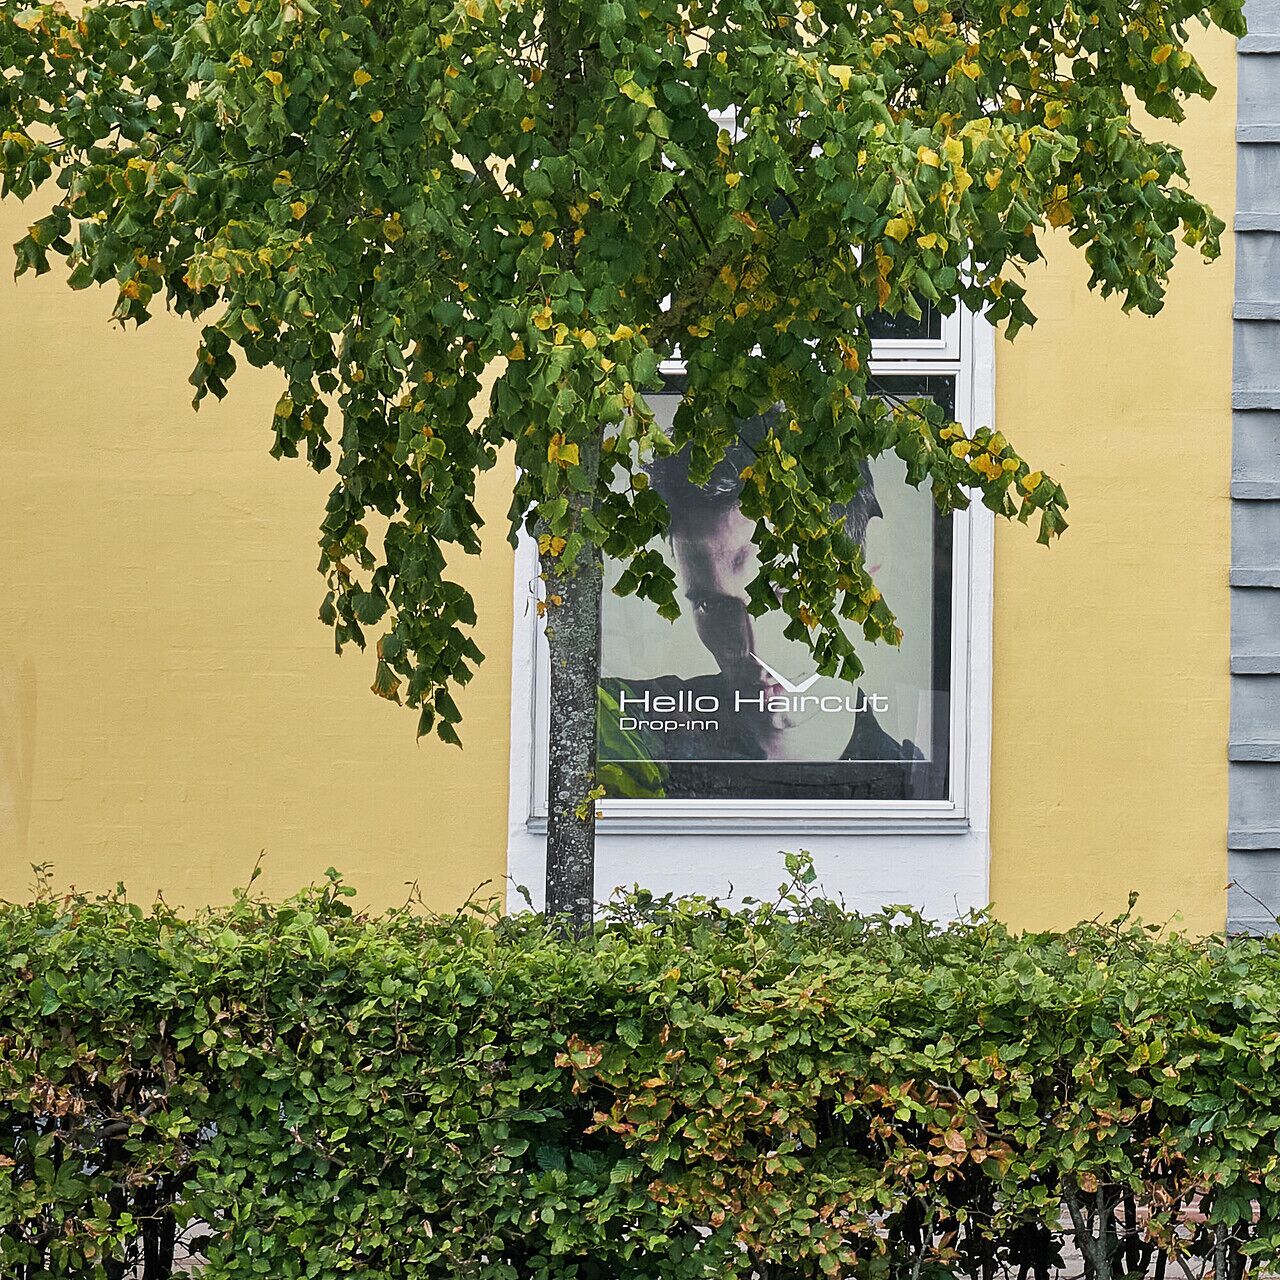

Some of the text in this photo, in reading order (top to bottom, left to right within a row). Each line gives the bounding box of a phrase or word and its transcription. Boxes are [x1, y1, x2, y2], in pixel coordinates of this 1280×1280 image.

[619, 690, 889, 713] Hello Haircut
[619, 717, 719, 732] Drop-inn
